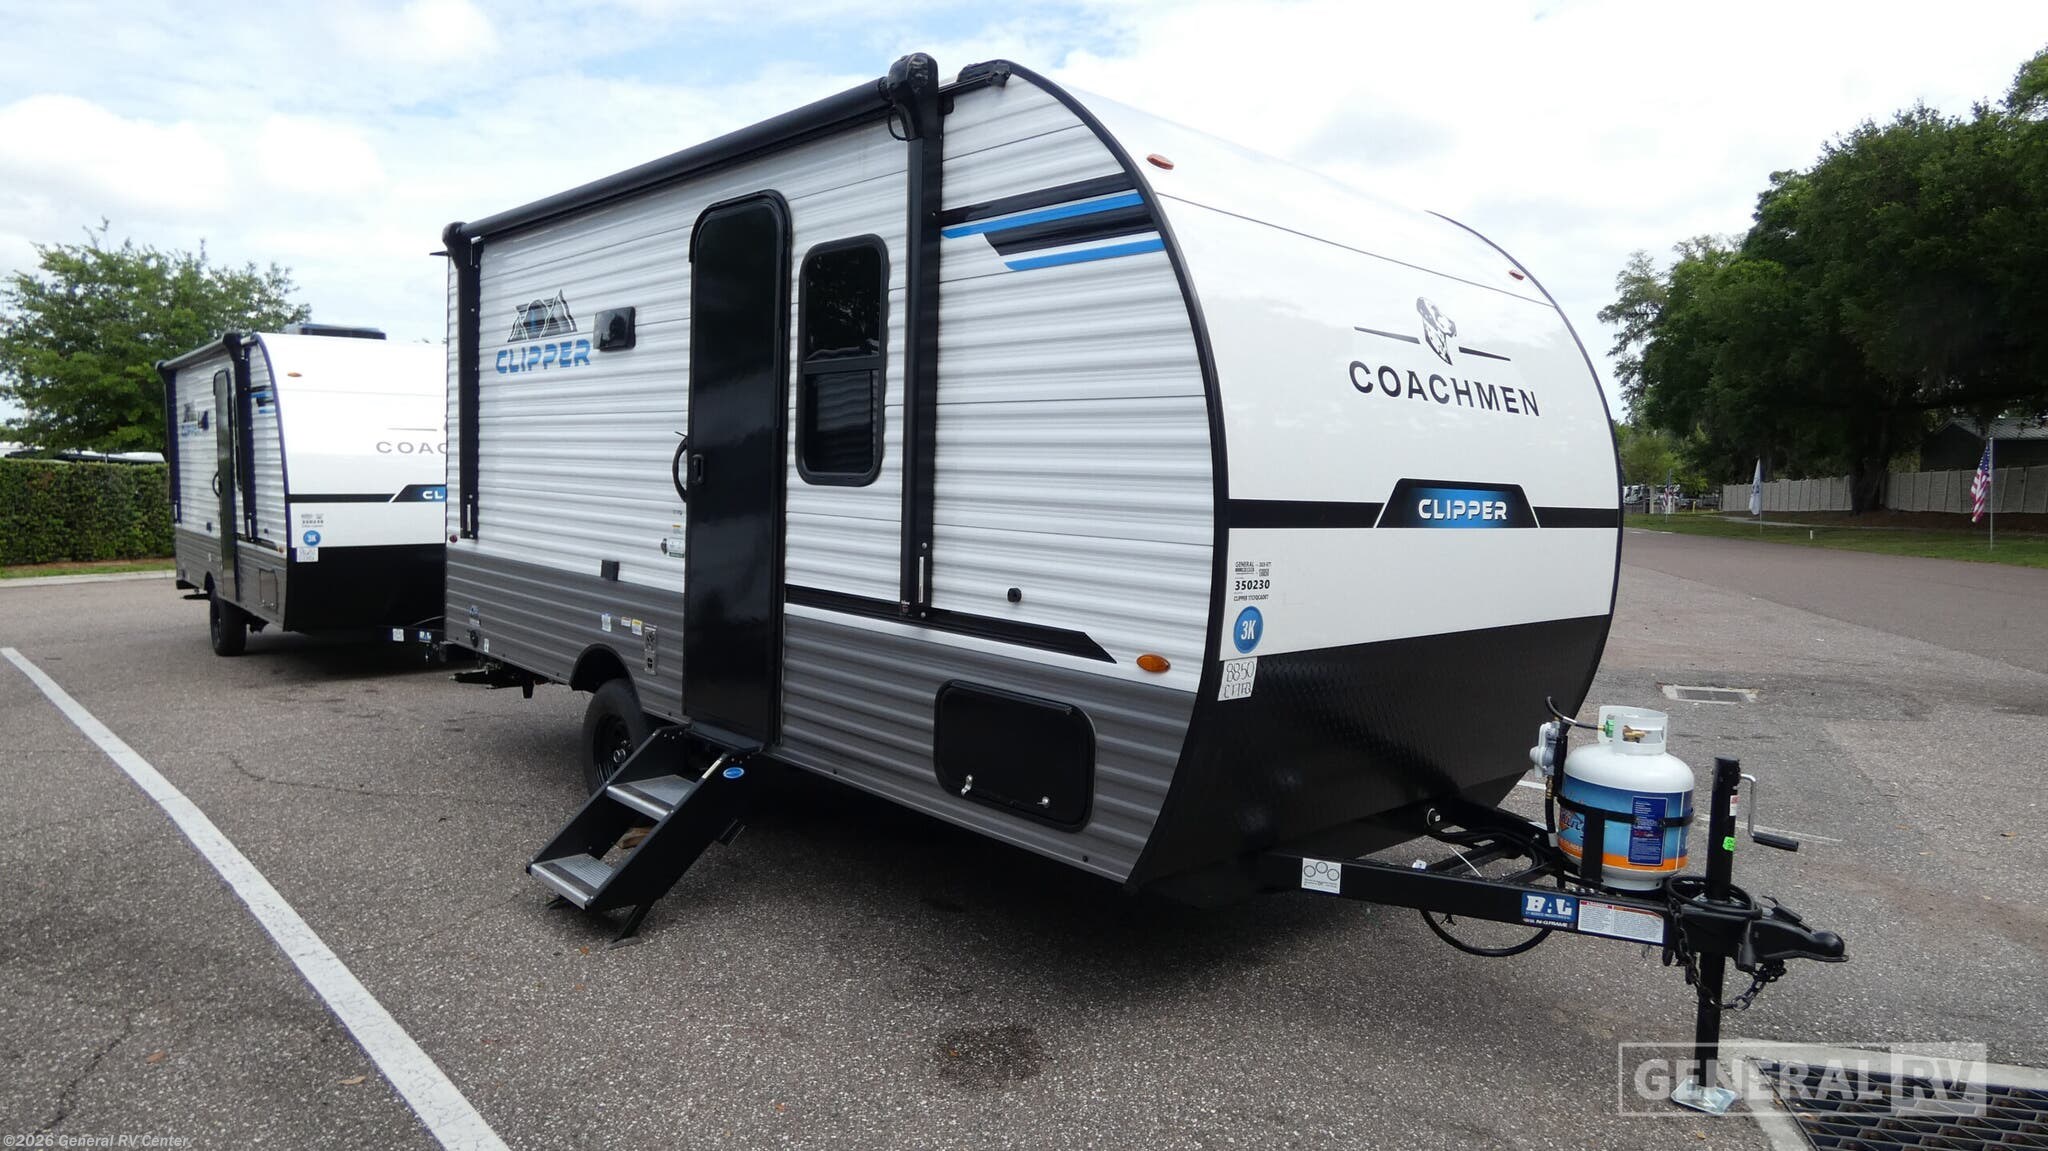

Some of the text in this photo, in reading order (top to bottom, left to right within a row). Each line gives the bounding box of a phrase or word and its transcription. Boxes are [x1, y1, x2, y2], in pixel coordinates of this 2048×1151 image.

[496, 339, 591, 374] CLIPPER
[1349, 360, 1540, 417] COACHMEN
[1418, 498, 1508, 521] CLIPPER
[1234, 579, 1270, 590] 350230
[1240, 620, 1256, 640] 3K
